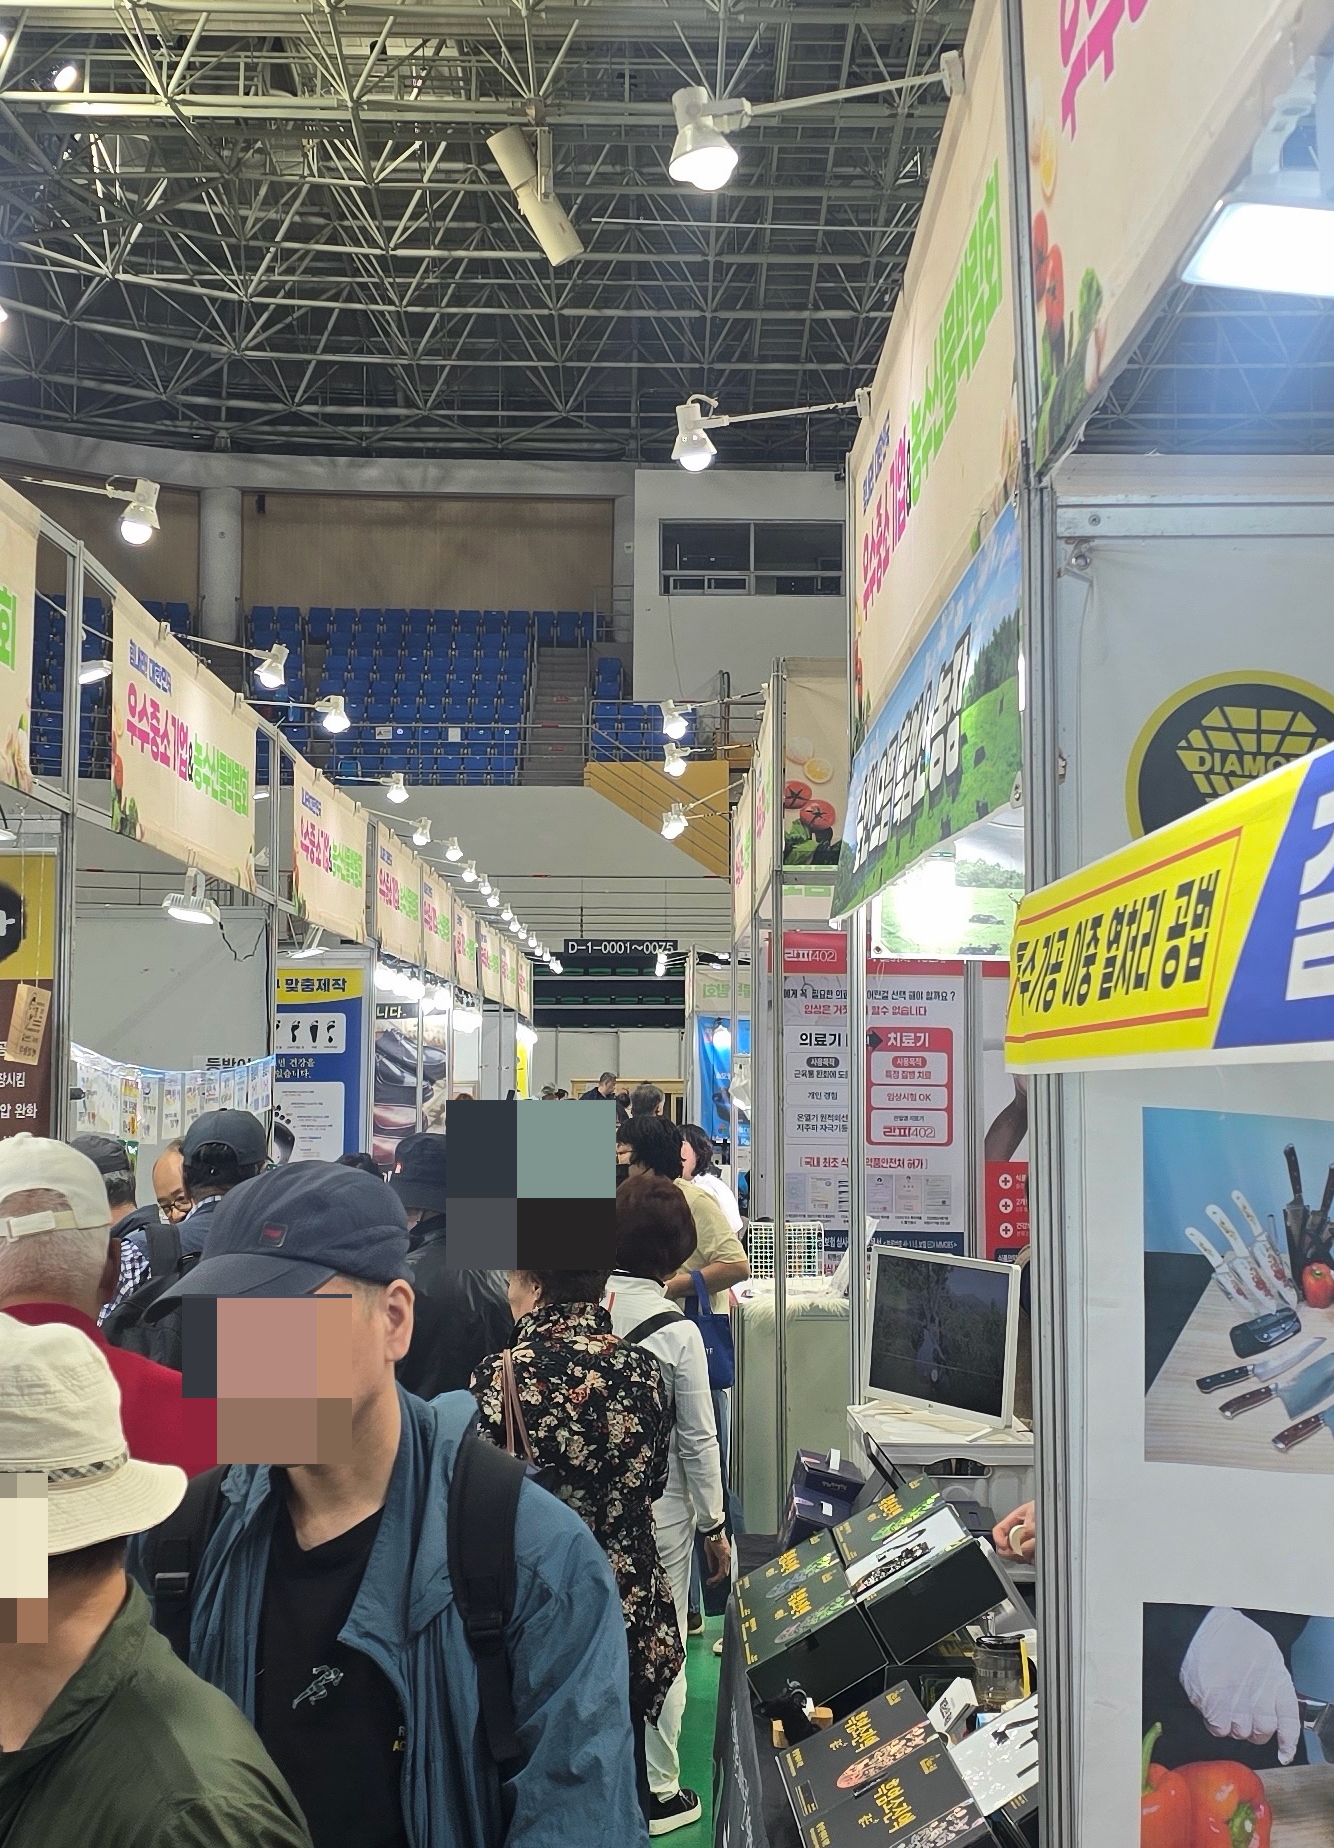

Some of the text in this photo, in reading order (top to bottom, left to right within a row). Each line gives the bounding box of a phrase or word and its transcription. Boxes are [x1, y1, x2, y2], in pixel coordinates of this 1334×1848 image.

[1195, 752, 1301, 774] DIAMO
[1099, 889, 1166, 1001] 열처리
[1160, 870, 1221, 990] 공법
[568, 940, 674, 956] D-1-0001~0075
[285, 978, 347, 993] 맞춤제작
[891, 991, 906, 1001] 선택
[891, 1006, 927, 1016] 없습니다
[799, 1033, 929, 1047] 의료기 치료기
[919, 1093, 931, 1102] OK
[14, 1102, 37, 1118] 완화
